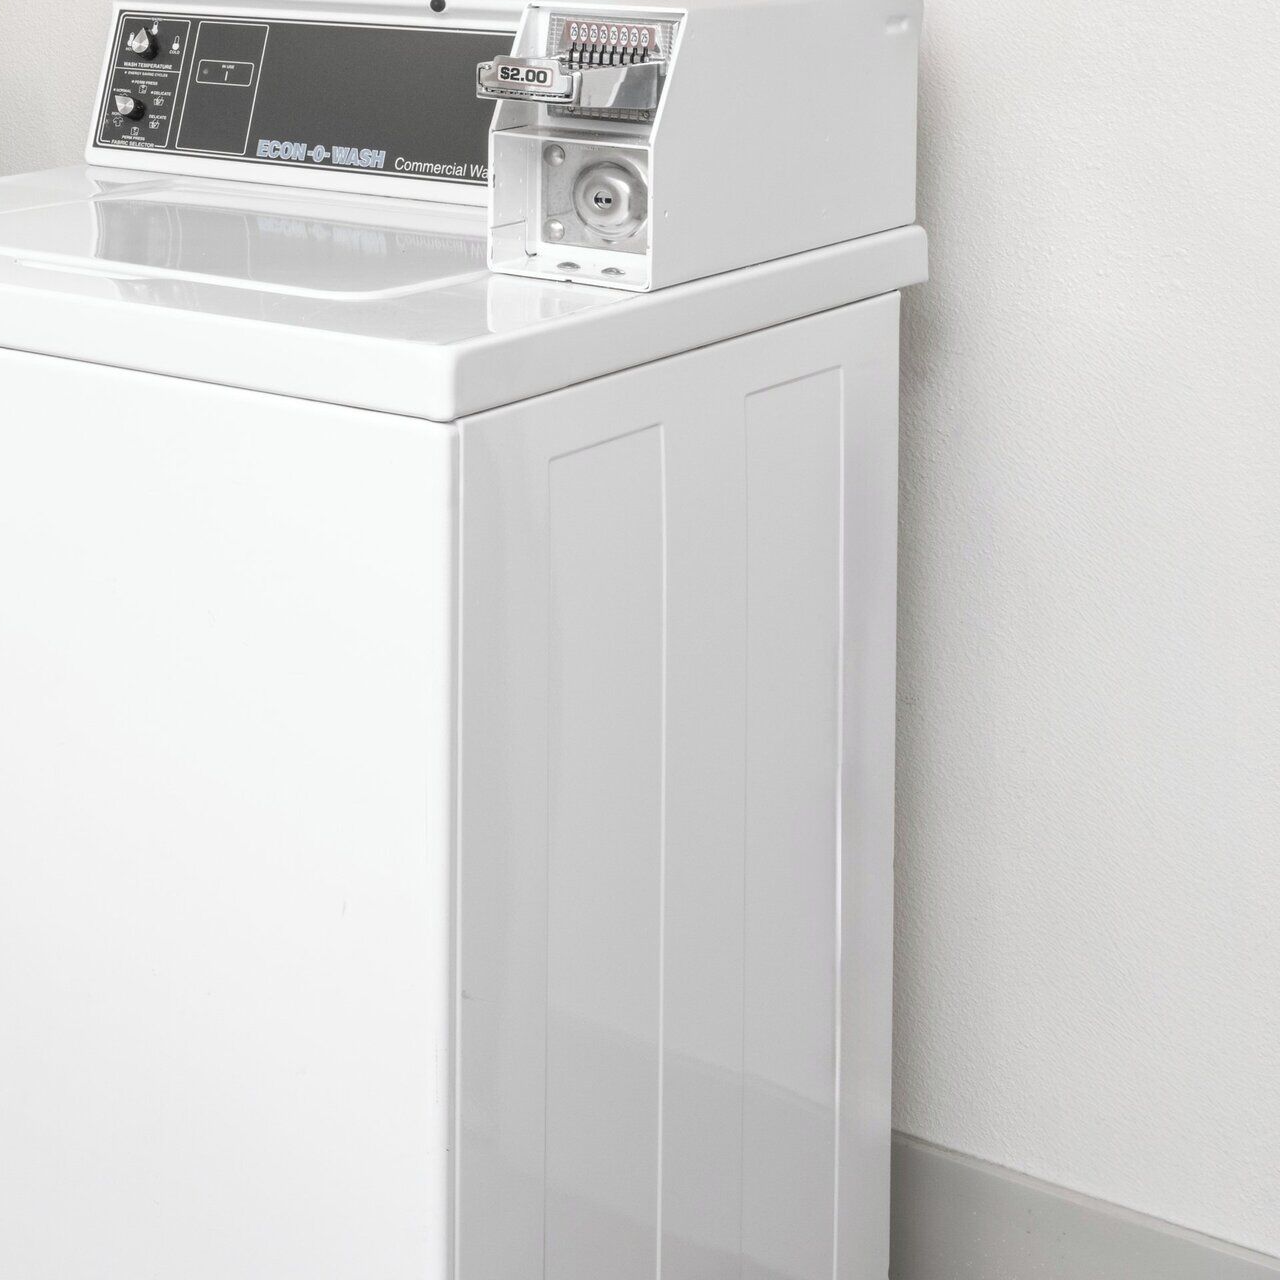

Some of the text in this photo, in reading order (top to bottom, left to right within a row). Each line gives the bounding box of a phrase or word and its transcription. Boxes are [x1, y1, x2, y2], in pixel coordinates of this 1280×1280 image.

[138, 62, 173, 70] TEMPERATURE
[500, 66, 547, 83] $2.00
[128, 140, 155, 148] SELECTOR
[394, 156, 467, 177] Commercial
